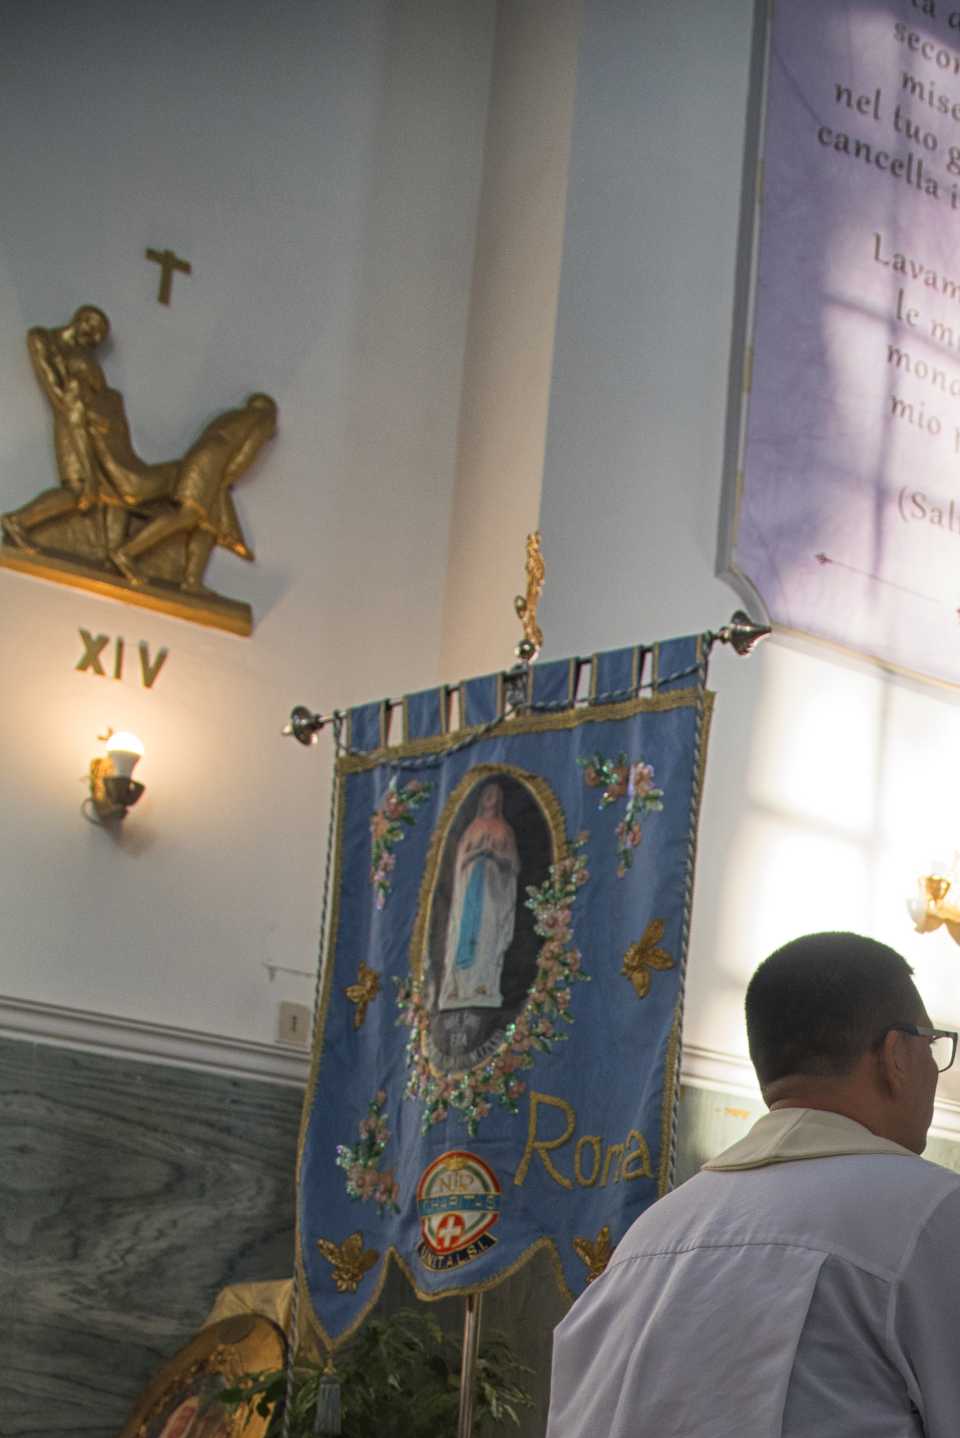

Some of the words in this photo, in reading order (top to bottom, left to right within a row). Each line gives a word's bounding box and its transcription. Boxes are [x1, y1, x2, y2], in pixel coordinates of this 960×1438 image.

[834, 82, 881, 121] nel
[893, 109, 939, 152] tuo
[817, 124, 940, 201] cancella
[895, 288, 921, 328] le
[890, 394, 943, 438] mio
[75, 627, 169, 689] XIV
